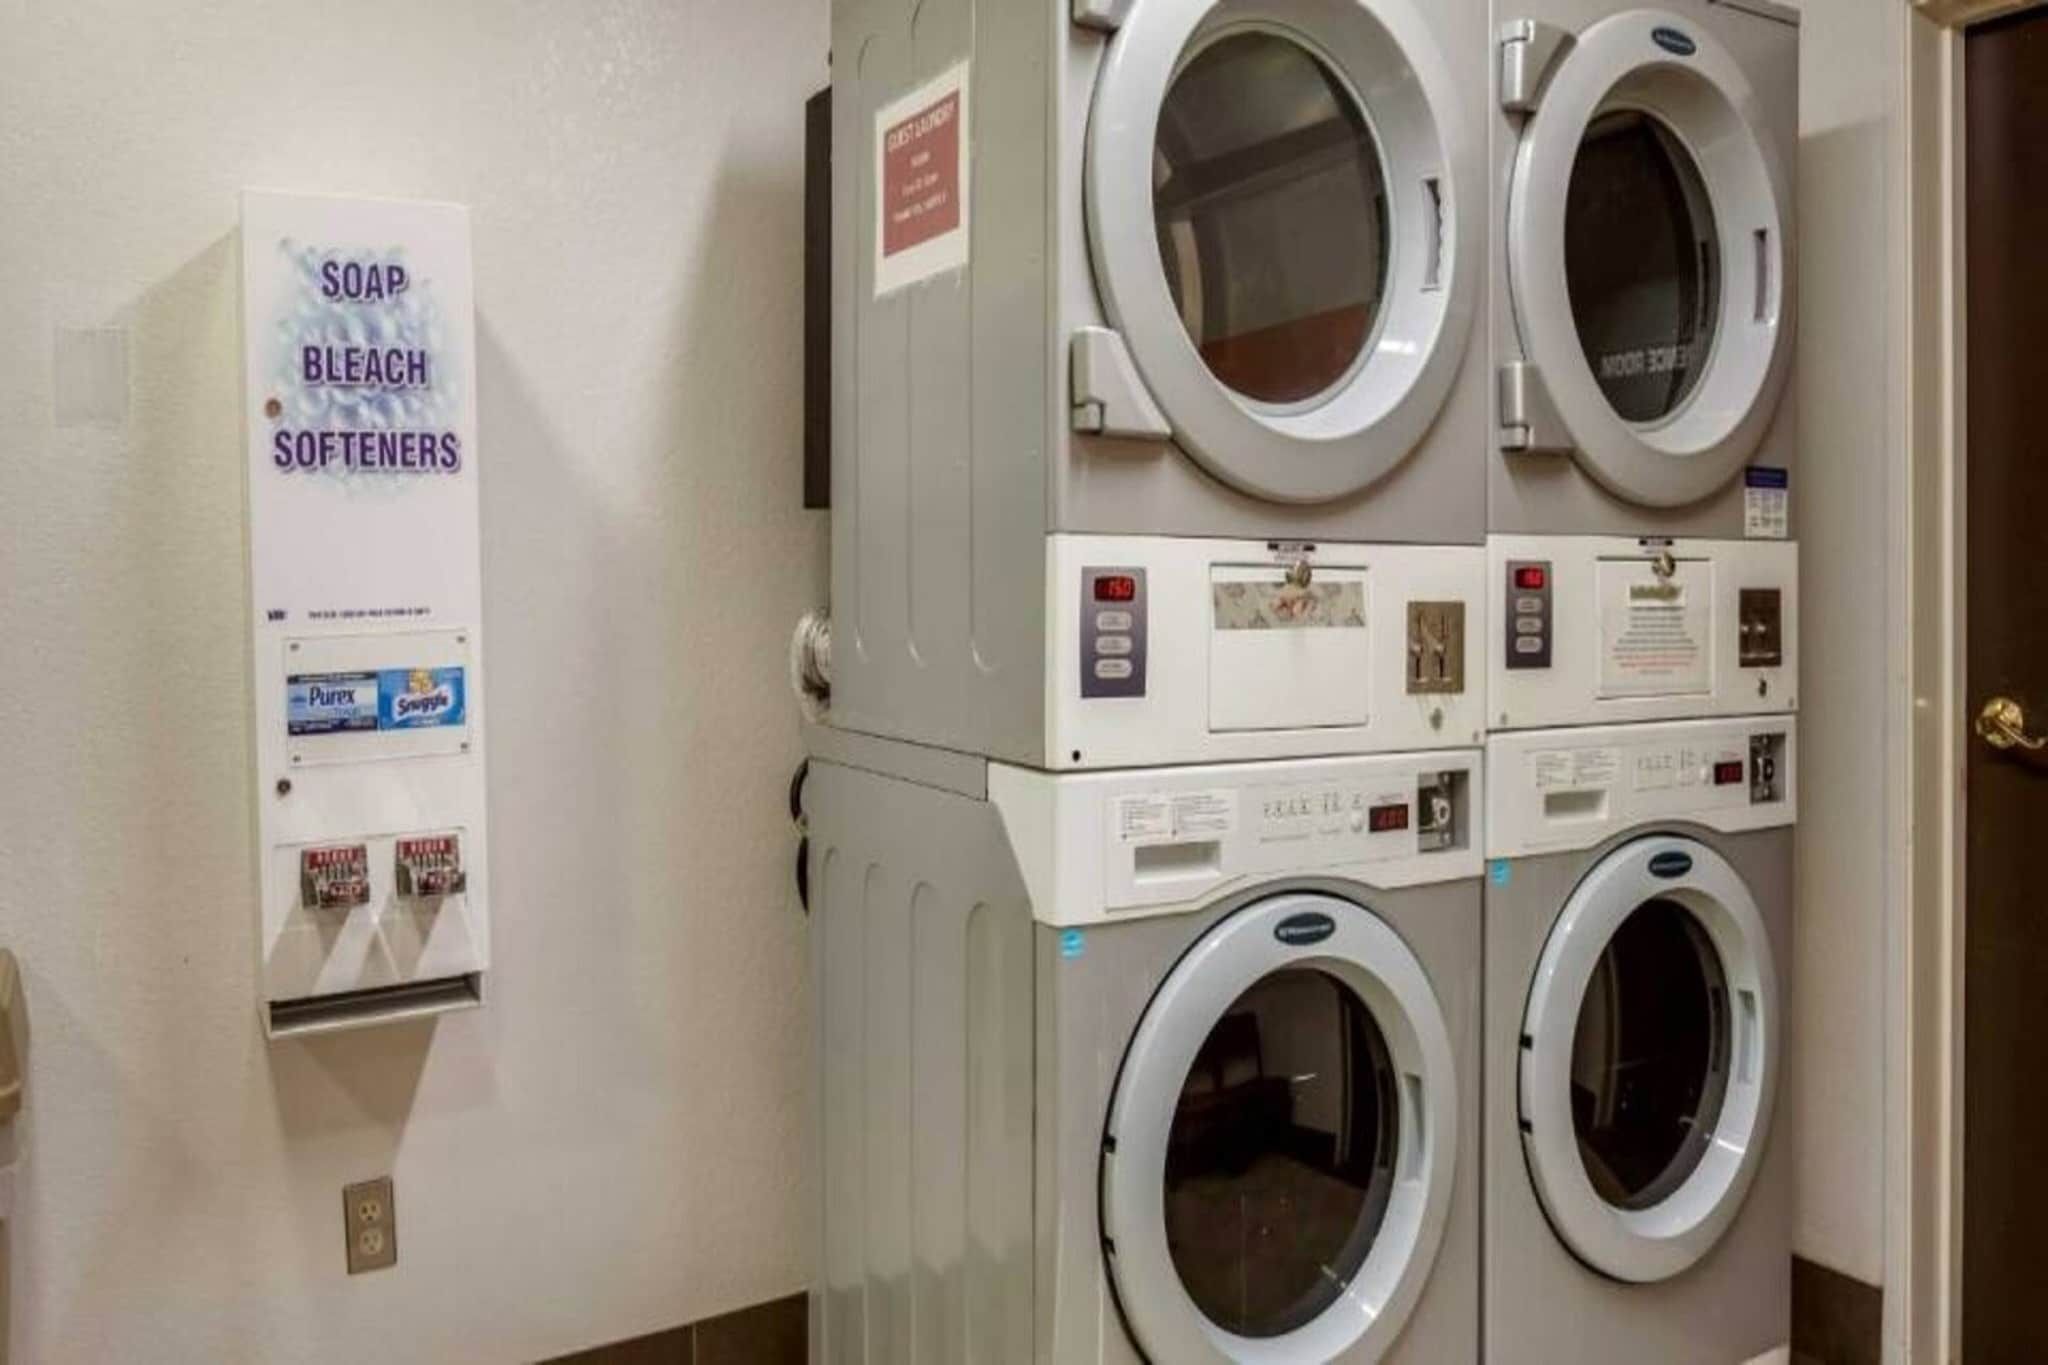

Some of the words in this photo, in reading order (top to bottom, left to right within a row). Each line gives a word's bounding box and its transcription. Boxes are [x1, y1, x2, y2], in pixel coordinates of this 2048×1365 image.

[888, 124, 914, 151] GUEST
[914, 102, 955, 138] LAUNDRY
[321, 260, 407, 301] SOAP
[302, 345, 428, 386] BLEACH
[273, 429, 460, 470] SOFTENERS
[309, 686, 356, 707] Purex
[397, 689, 449, 716] Snuggle
